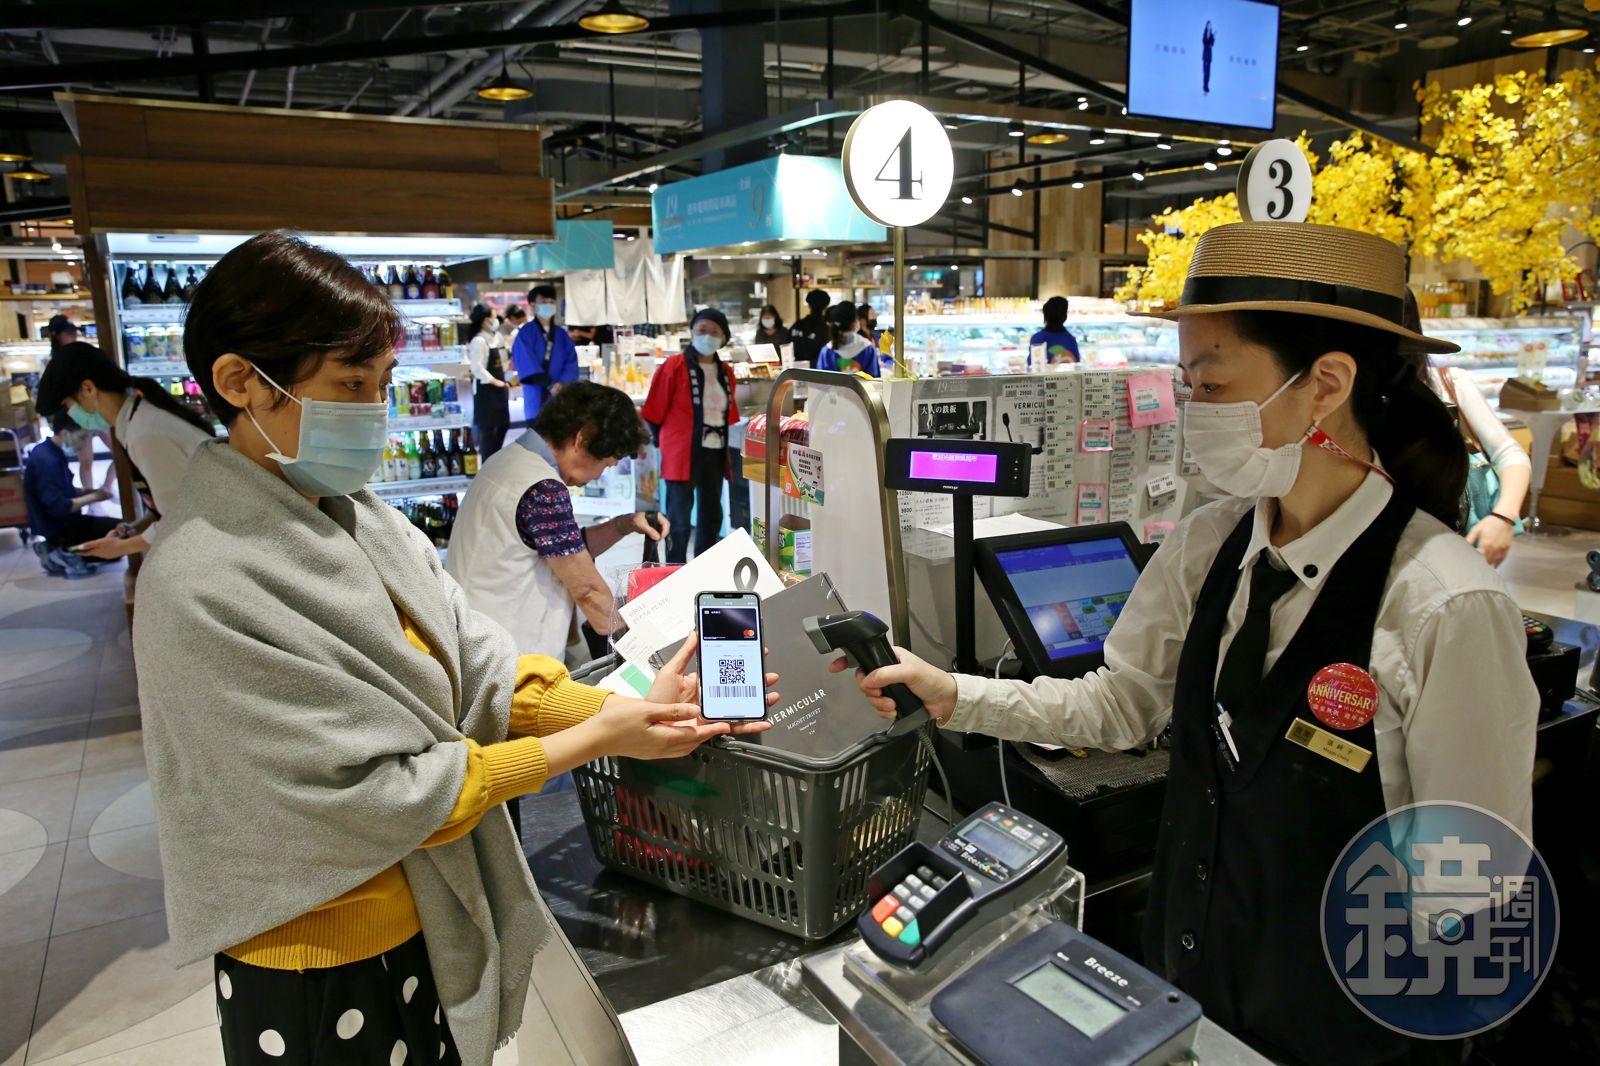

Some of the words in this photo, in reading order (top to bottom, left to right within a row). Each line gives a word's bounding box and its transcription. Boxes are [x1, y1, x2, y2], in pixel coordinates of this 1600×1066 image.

[875, 126, 923, 200] 4
[1267, 159, 1294, 219] 3
[767, 688, 827, 726] VERMICULAR
[1309, 682, 1376, 711] ANNIVERSARY
[1084, 956, 1129, 988] Breeze
